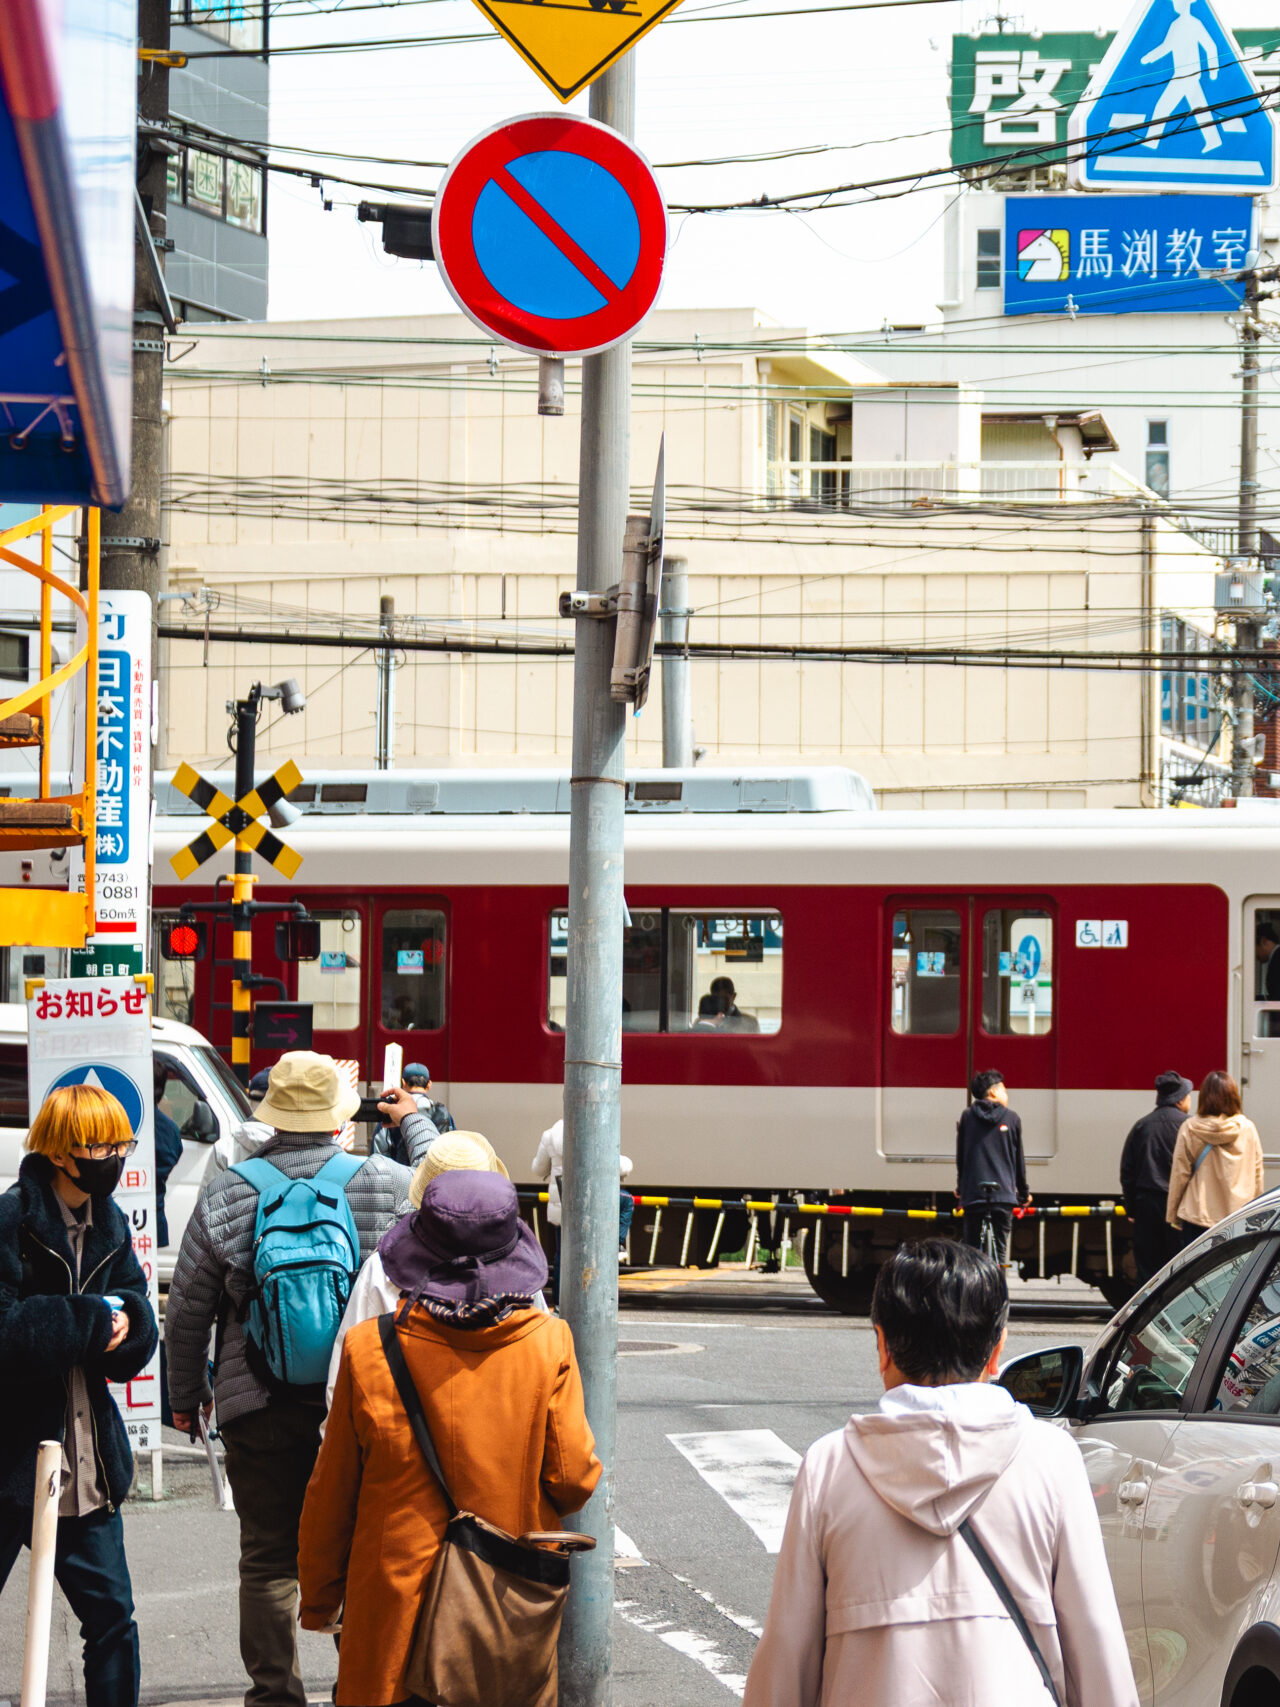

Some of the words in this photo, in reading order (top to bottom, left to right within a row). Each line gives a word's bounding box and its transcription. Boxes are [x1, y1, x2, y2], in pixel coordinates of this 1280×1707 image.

[78, 886, 138, 899] 5-0881
[86, 964, 129, 976] 朝日町
[36, 988, 146, 1020] お知らせ
